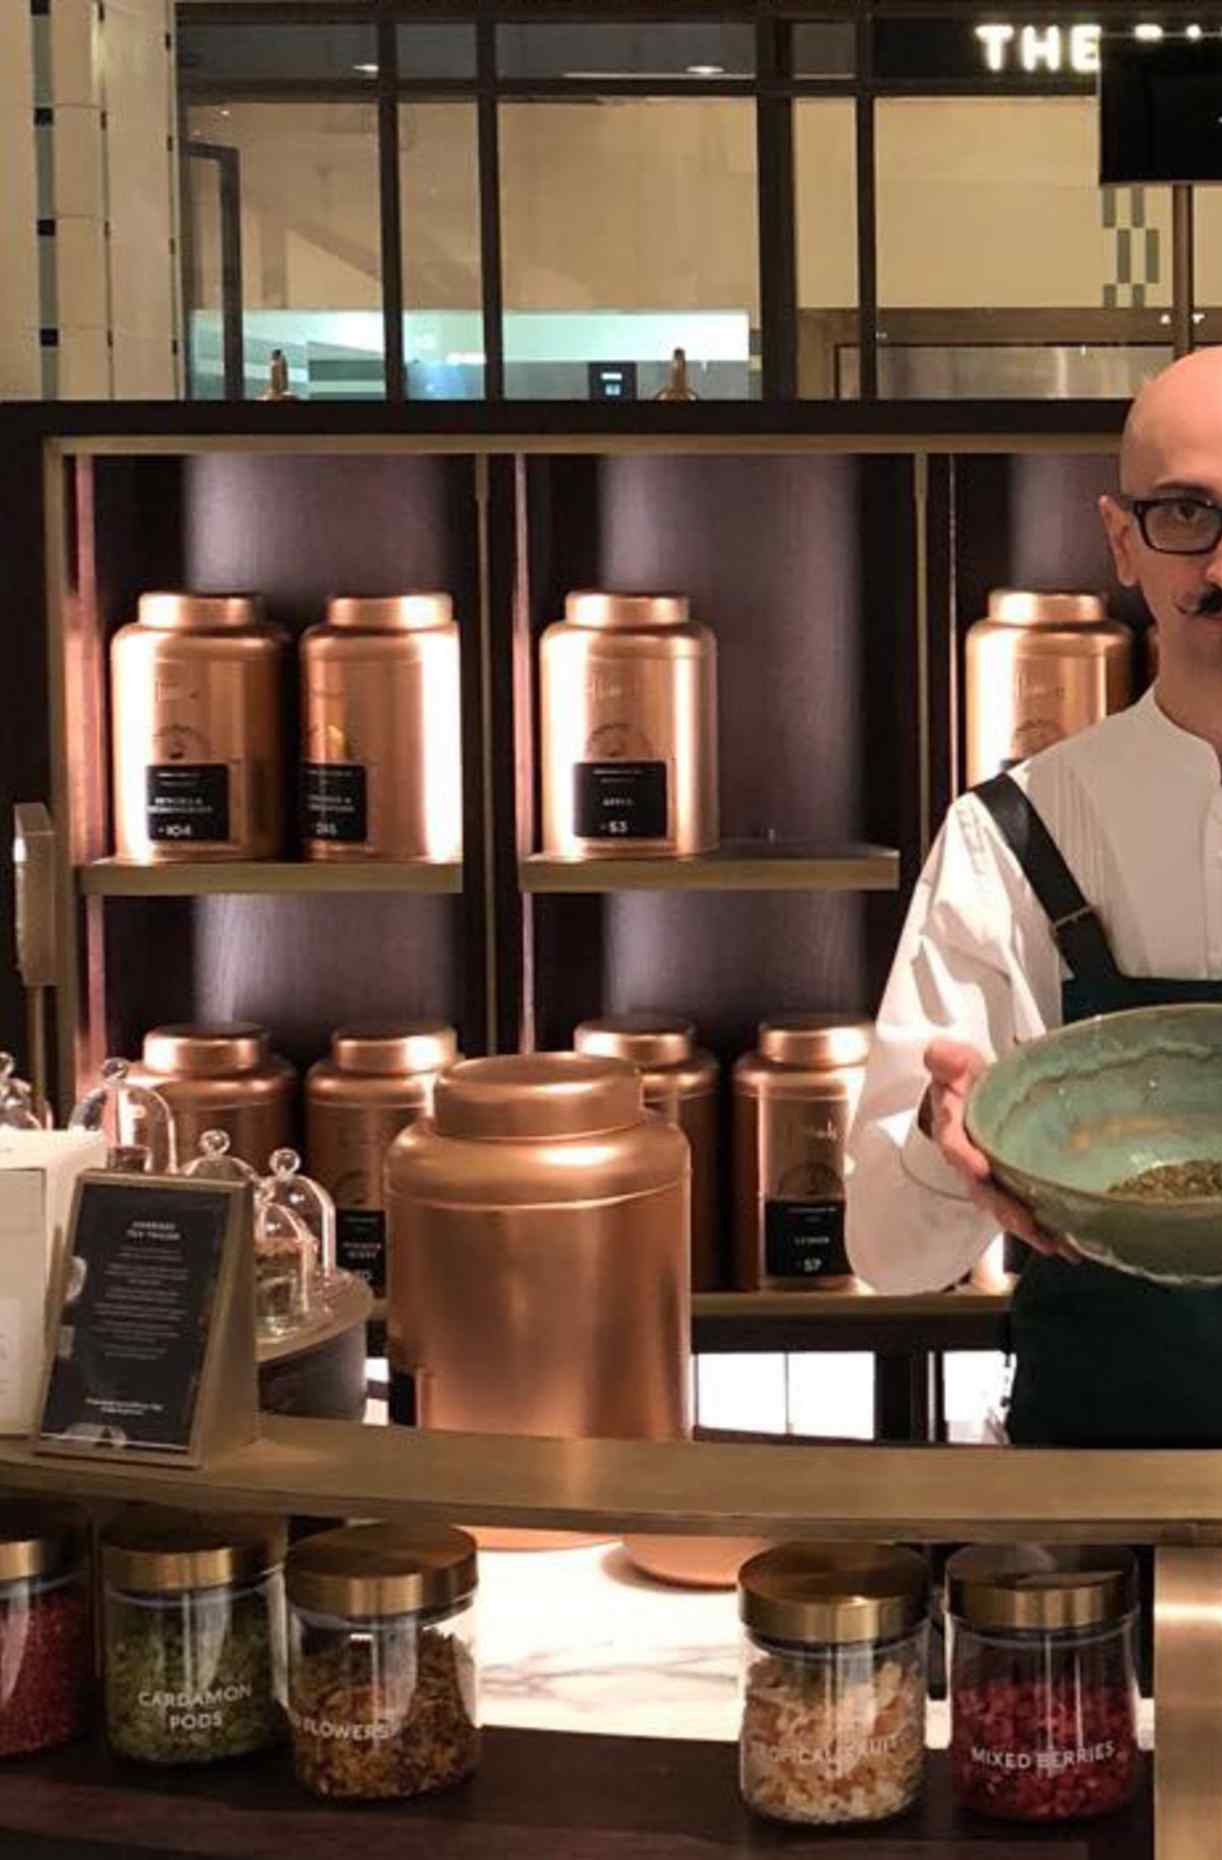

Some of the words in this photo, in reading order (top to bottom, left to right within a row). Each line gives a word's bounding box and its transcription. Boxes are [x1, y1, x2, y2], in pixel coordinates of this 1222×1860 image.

[974, 23, 1102, 73] THE
[137, 1683, 252, 1708] CARDAMON
[169, 1711, 223, 1730] PODS
[970, 1745, 1032, 1769] MIXED
[1036, 1739, 1115, 1769] BERRIES
